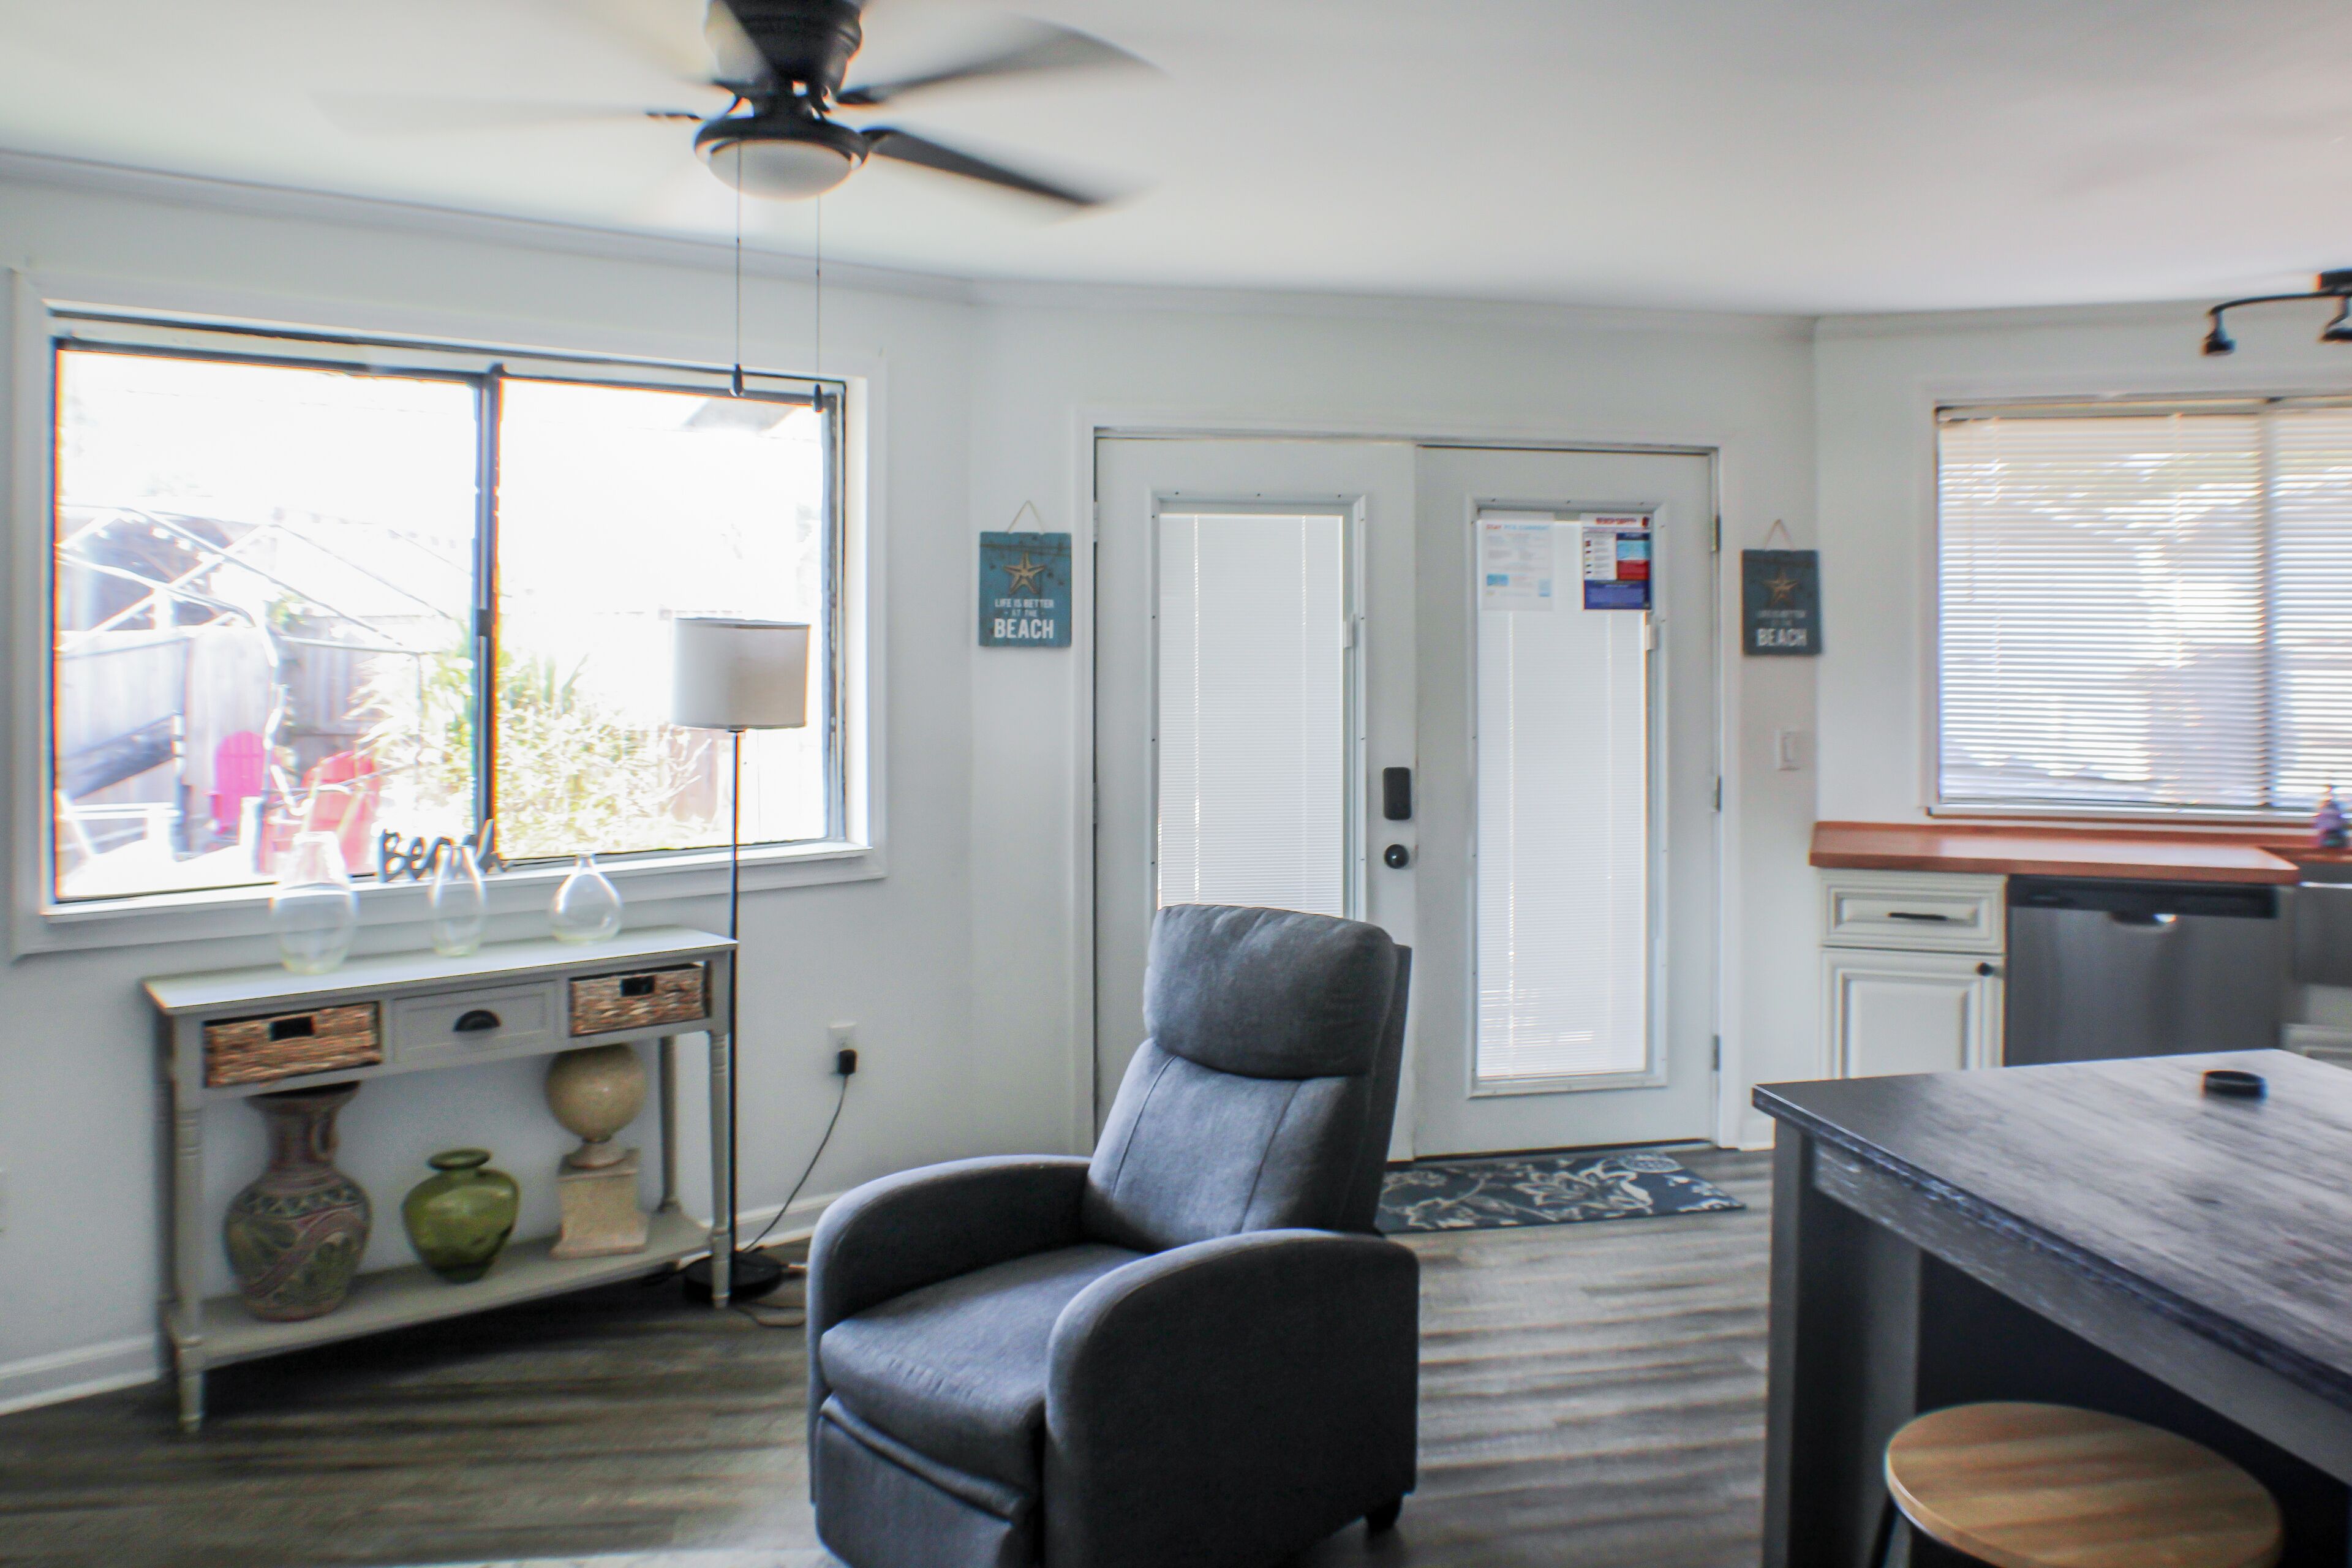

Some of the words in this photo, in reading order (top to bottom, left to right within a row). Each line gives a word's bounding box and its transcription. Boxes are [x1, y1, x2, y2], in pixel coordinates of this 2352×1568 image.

[994, 598, 1012, 608] LIFE
[1014, 598, 1022, 608] IS
[1023, 598, 1054, 608] BETTER
[994, 618, 1054, 639] BEACH
